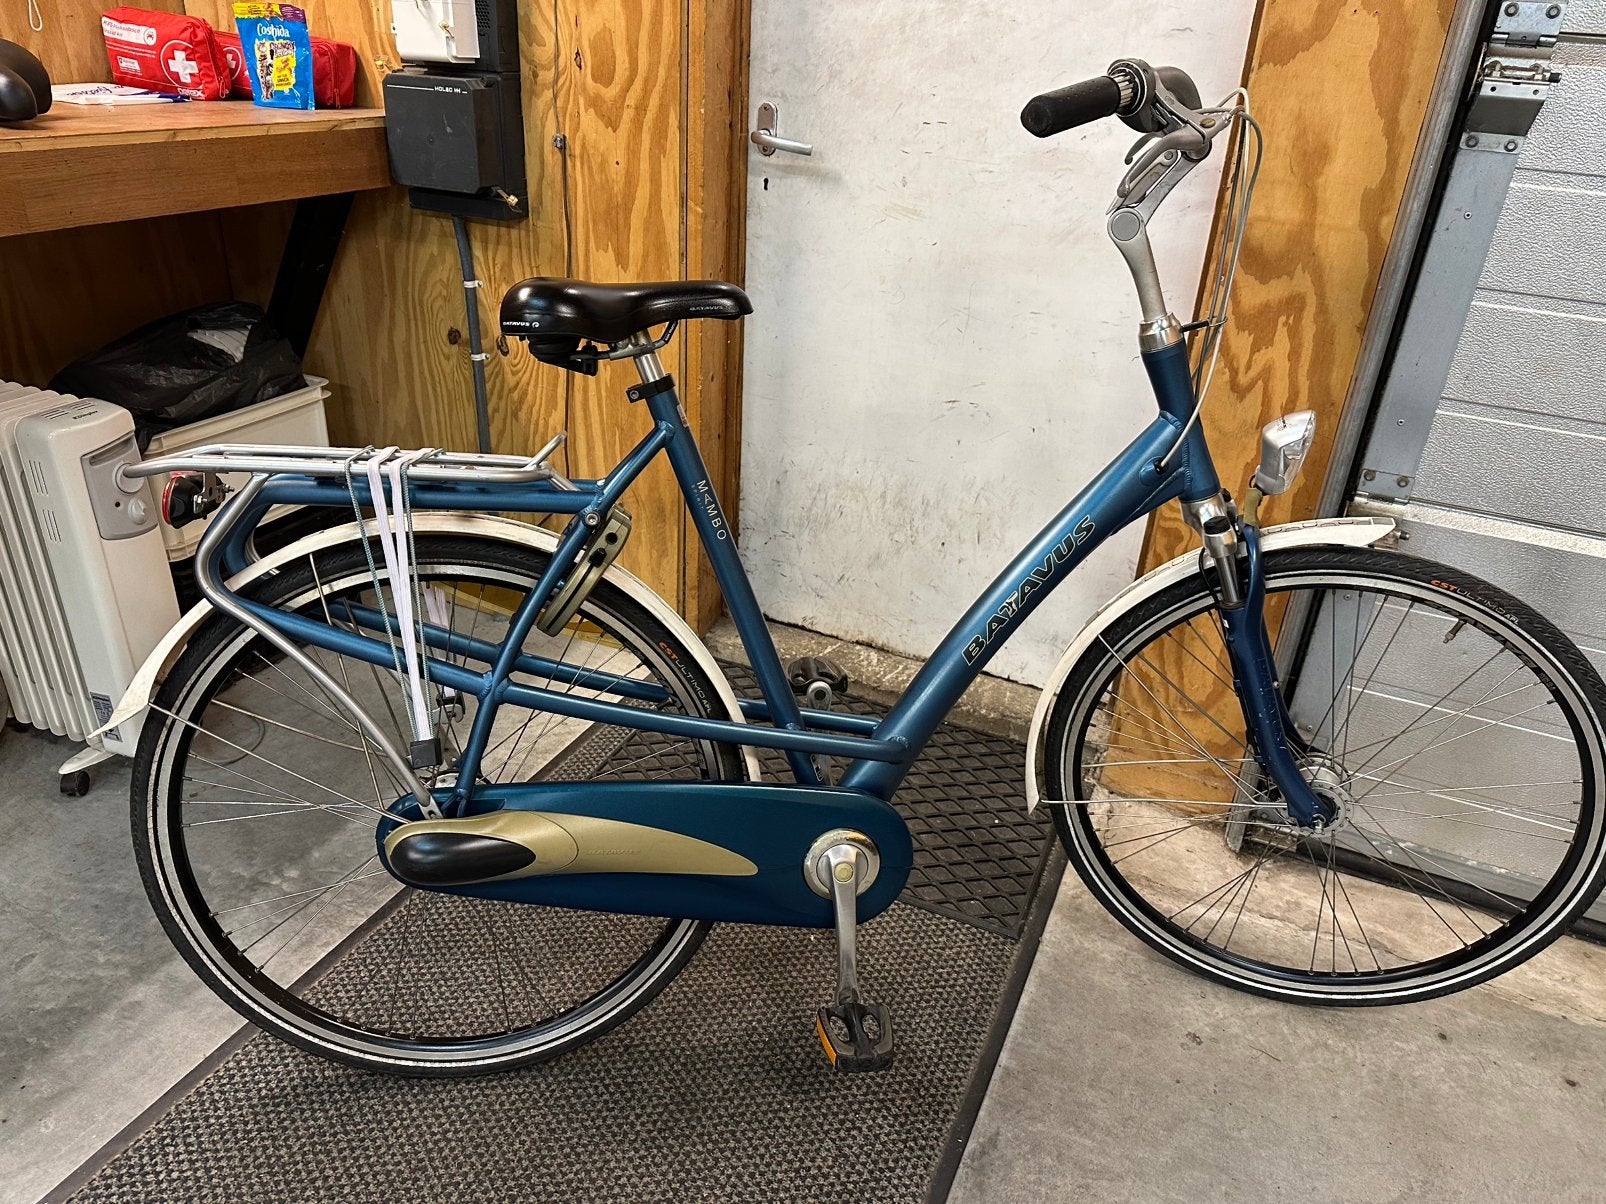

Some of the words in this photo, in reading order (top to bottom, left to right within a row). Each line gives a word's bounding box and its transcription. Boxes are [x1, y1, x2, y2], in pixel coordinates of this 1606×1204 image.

[257, 23, 290, 38] Coshida
[696, 479, 727, 540] MAMBO
[962, 514, 1096, 666] BATAVUS
[1430, 579, 1457, 592] CST
[1456, 587, 1506, 614] ULTIMO
[658, 641, 679, 661] CST
[675, 659, 706, 699] ULTIMO
